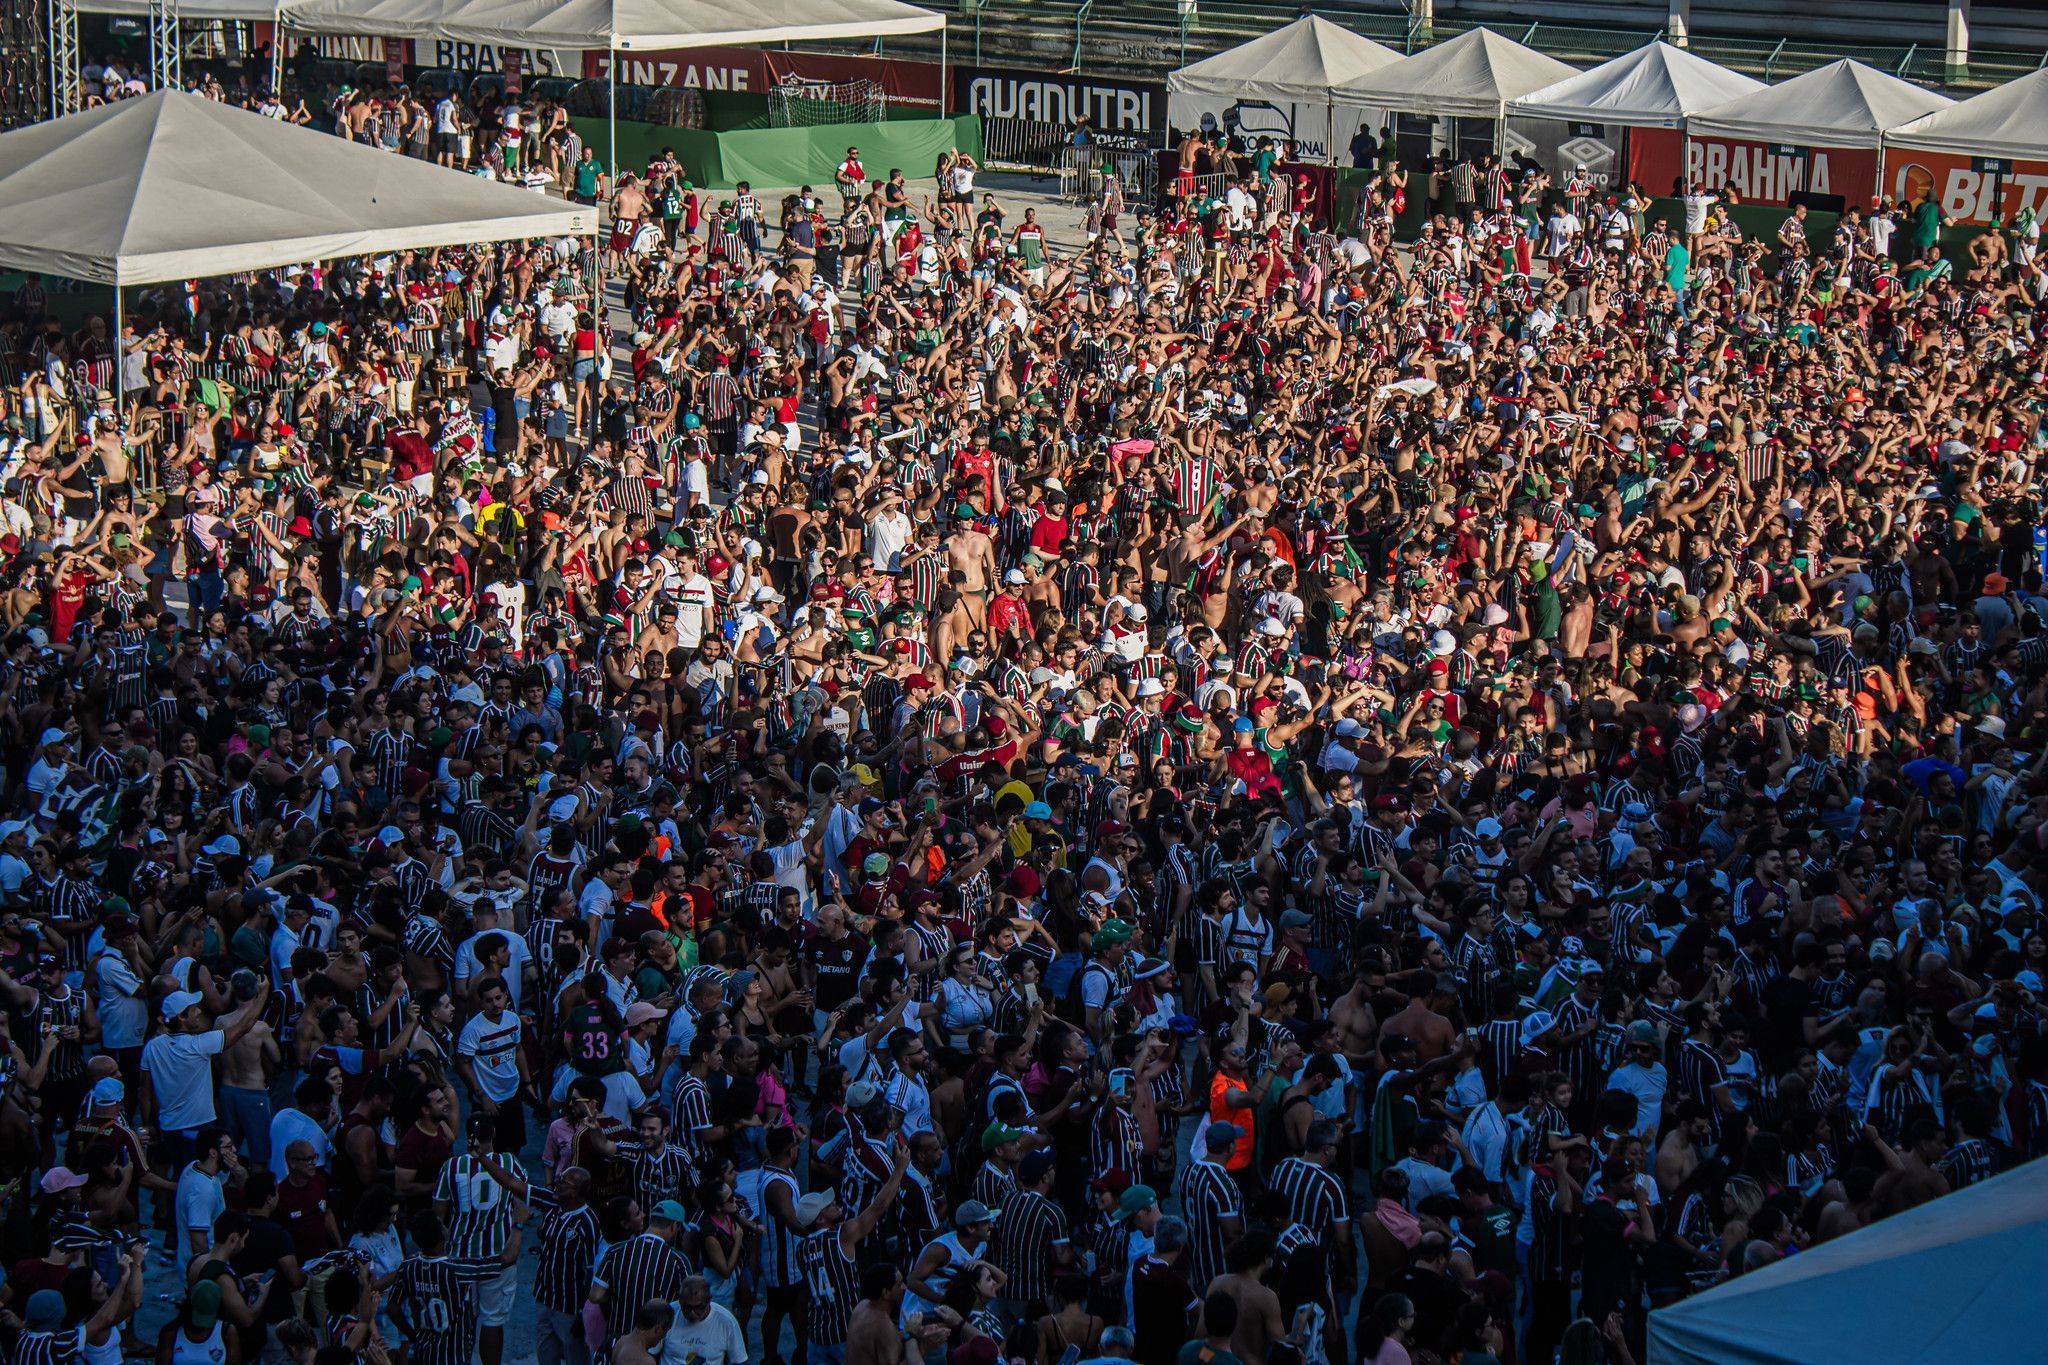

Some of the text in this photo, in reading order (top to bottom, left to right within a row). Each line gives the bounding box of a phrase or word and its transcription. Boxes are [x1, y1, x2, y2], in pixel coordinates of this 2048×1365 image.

[436, 39, 553, 77] BRAAS
[1685, 142, 1831, 201] BRAHMA
[667, 201, 681, 215] 12
[1942, 168, 2048, 225] BET
[617, 220, 632, 236] 02
[441, 418, 471, 440] AMPE
[505, 605, 517, 629] 9
[960, 761, 985, 771] Unim
[821, 964, 852, 975] BETANO
[581, 1031, 610, 1061] 33
[456, 1172, 502, 1214] 10
